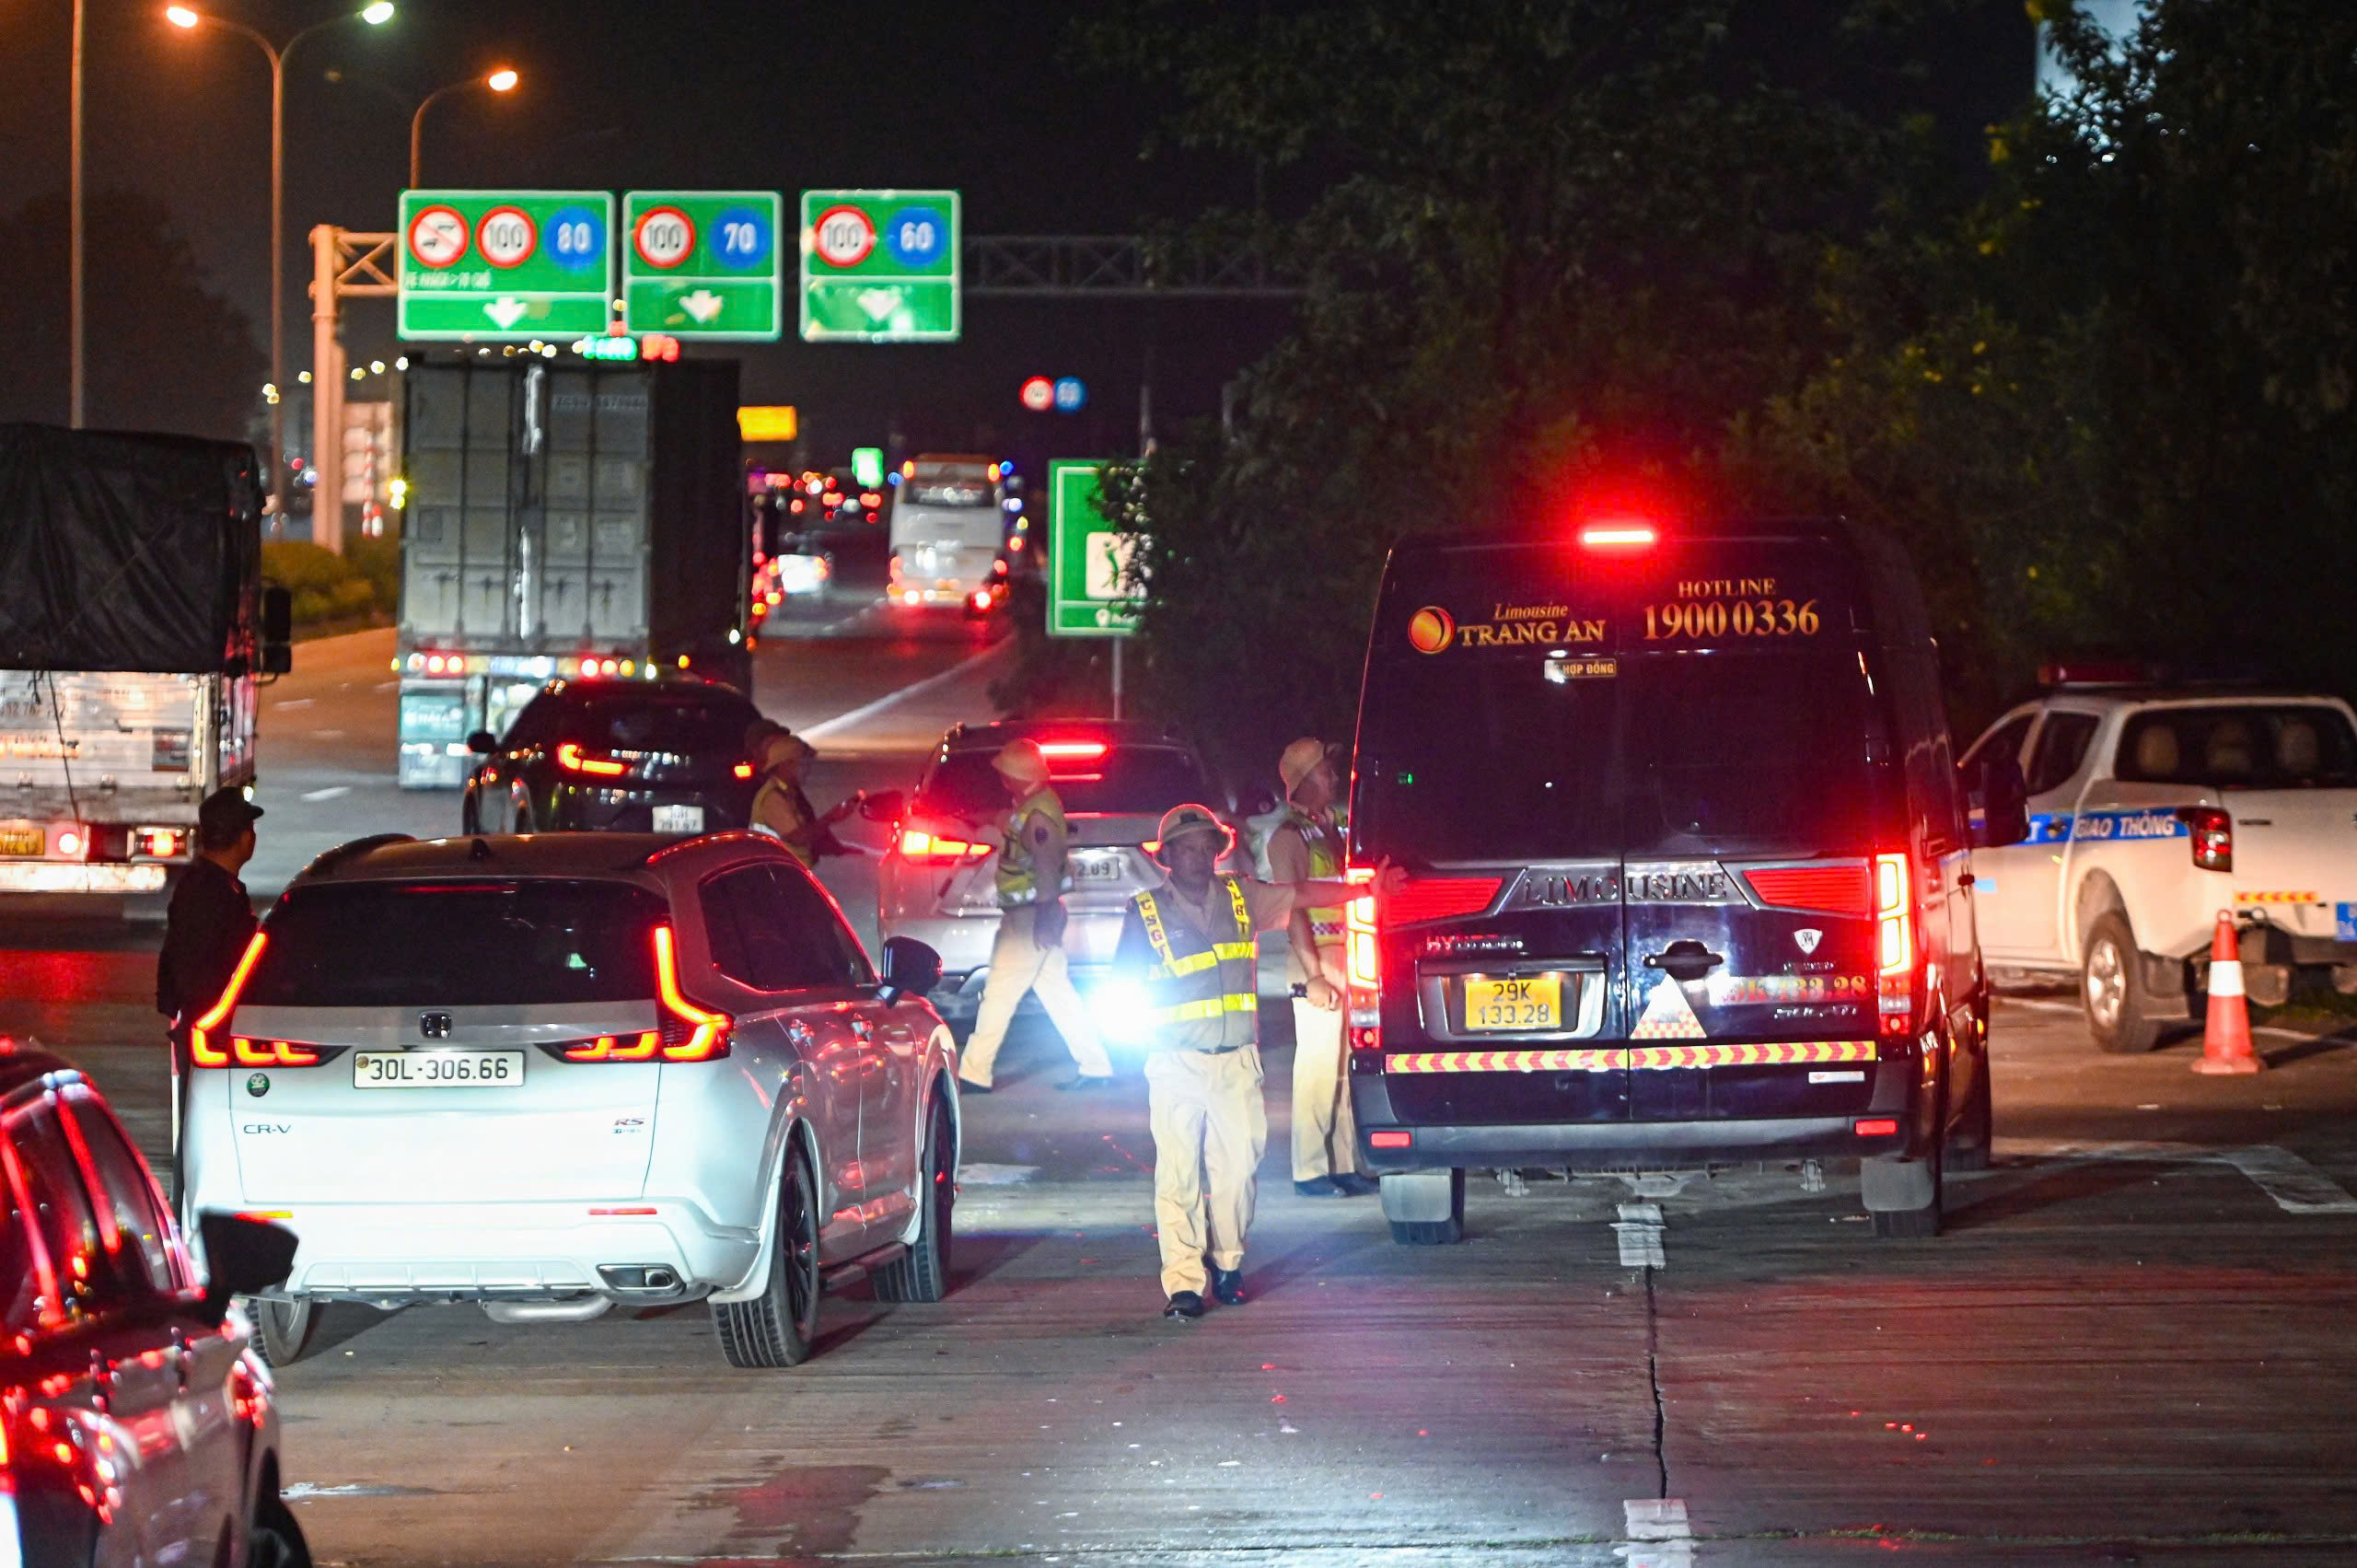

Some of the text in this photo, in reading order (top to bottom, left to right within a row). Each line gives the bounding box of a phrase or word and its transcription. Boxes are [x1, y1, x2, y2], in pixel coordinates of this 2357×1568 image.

[488, 223, 524, 250] 100
[557, 222, 592, 253] 80
[647, 224, 682, 251] 100
[724, 222, 757, 254] 70
[823, 223, 860, 250] 100
[900, 222, 935, 252] 60
[1678, 578, 1776, 598] HOTLINE
[1493, 601, 1568, 621] Limousine
[1457, 620, 1606, 646] TRANG AN
[2075, 809, 2177, 838] GIAO THÔNG
[1524, 872, 1728, 905] LIMOUSINE
[1492, 981, 1531, 1002] 29K
[1478, 1004, 1550, 1024] 133.28
[370, 1058, 508, 1080] 30L-306.66
[243, 1123, 291, 1134] CR-V
[613, 1118, 644, 1126] RS
